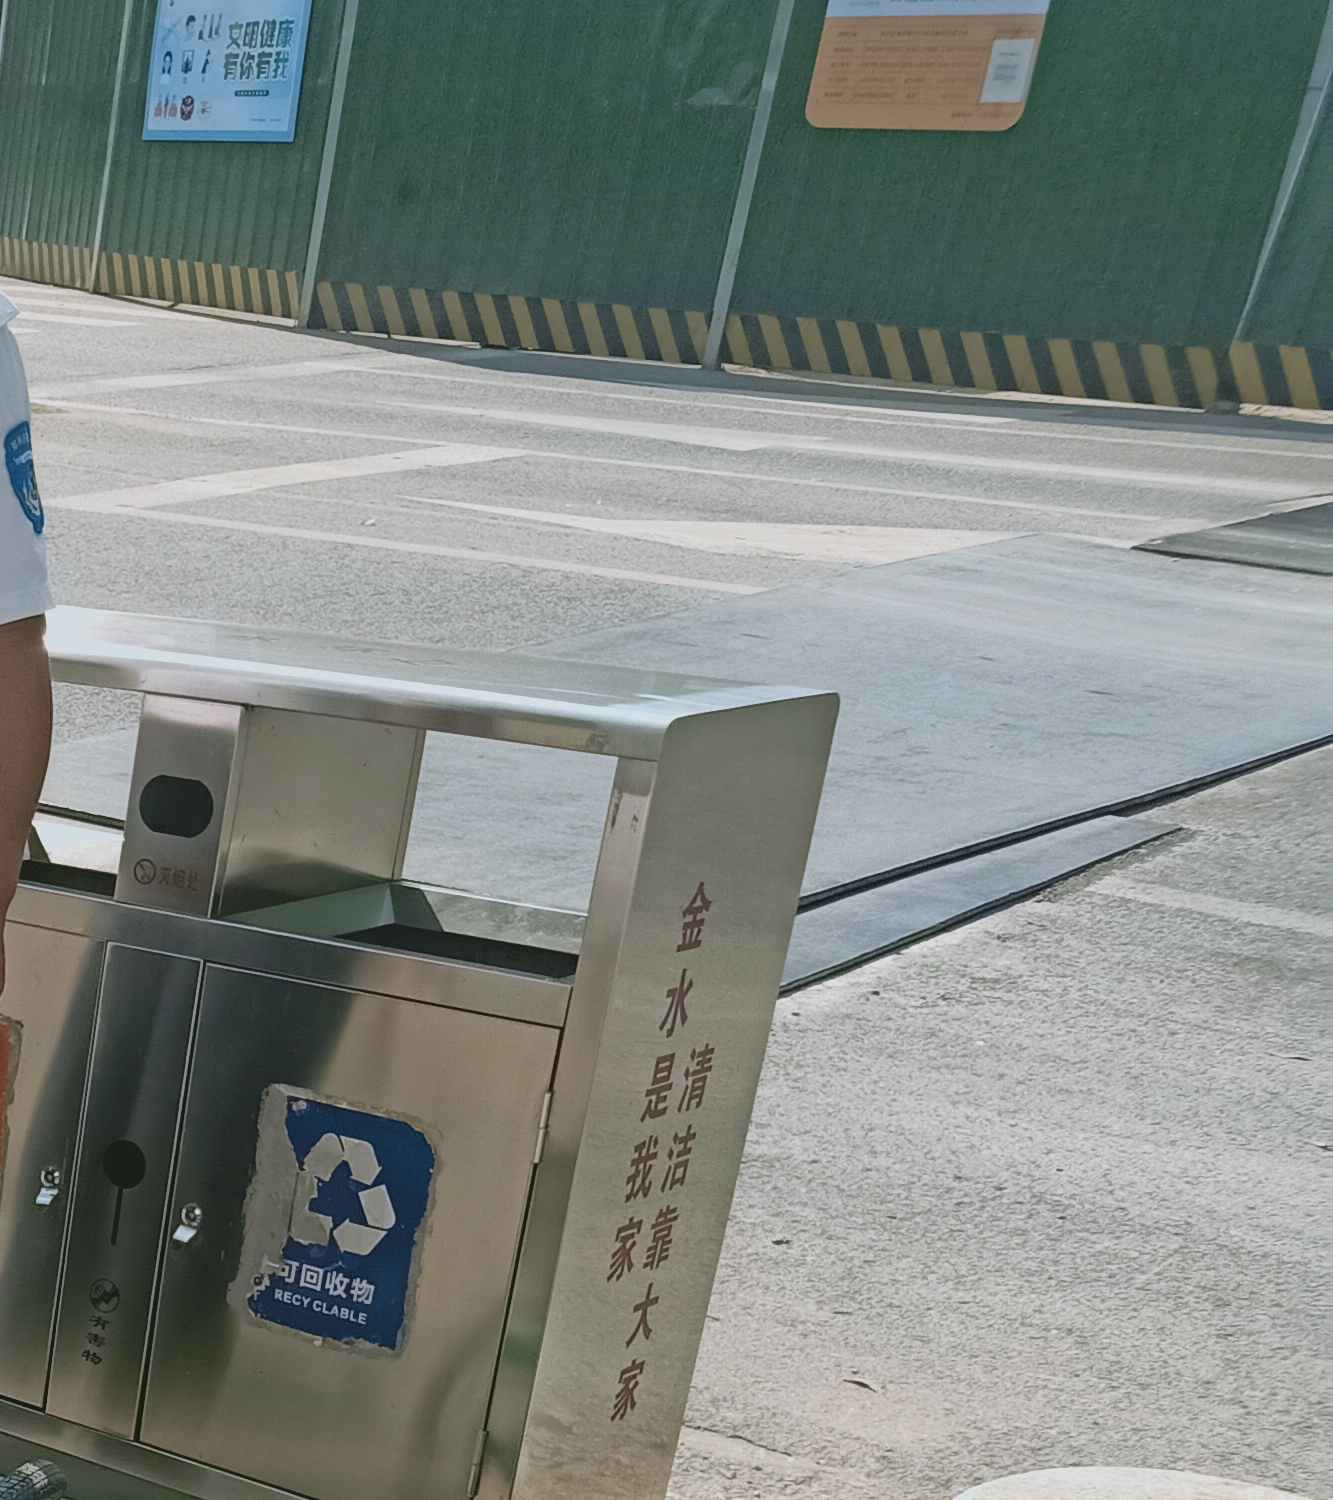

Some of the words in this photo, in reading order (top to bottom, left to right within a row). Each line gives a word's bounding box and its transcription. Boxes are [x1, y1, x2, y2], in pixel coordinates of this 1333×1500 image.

[226, 19, 295, 49] 文明健康
[223, 50, 290, 80] 有你有我
[606, 880, 712, 1283] 金水是我家
[610, 1042, 715, 1423] 清洁靠大家
[276, 1259, 376, 1305] 可回收物
[80, 1314, 111, 1366] 有害物
